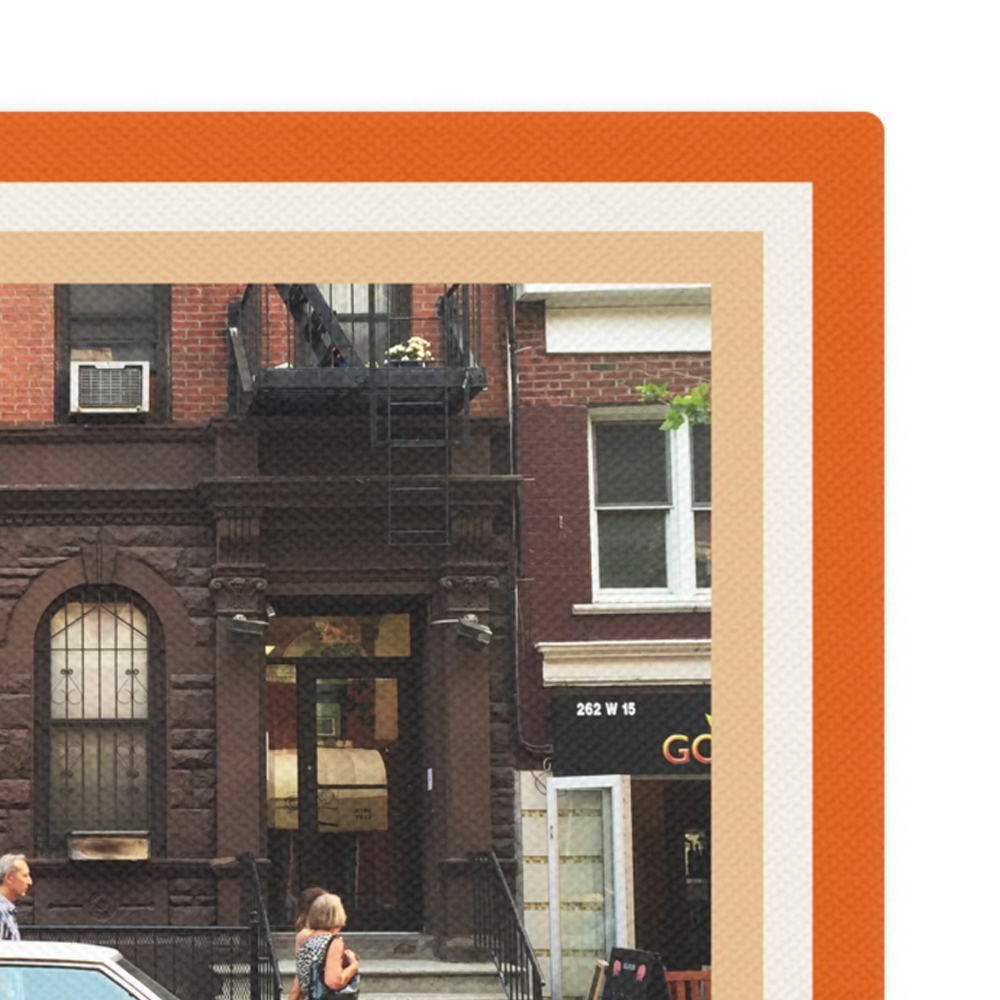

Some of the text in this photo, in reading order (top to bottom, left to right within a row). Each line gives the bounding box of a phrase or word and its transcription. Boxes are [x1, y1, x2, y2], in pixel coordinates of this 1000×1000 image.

[576, 702, 636, 716] 262 W 15
